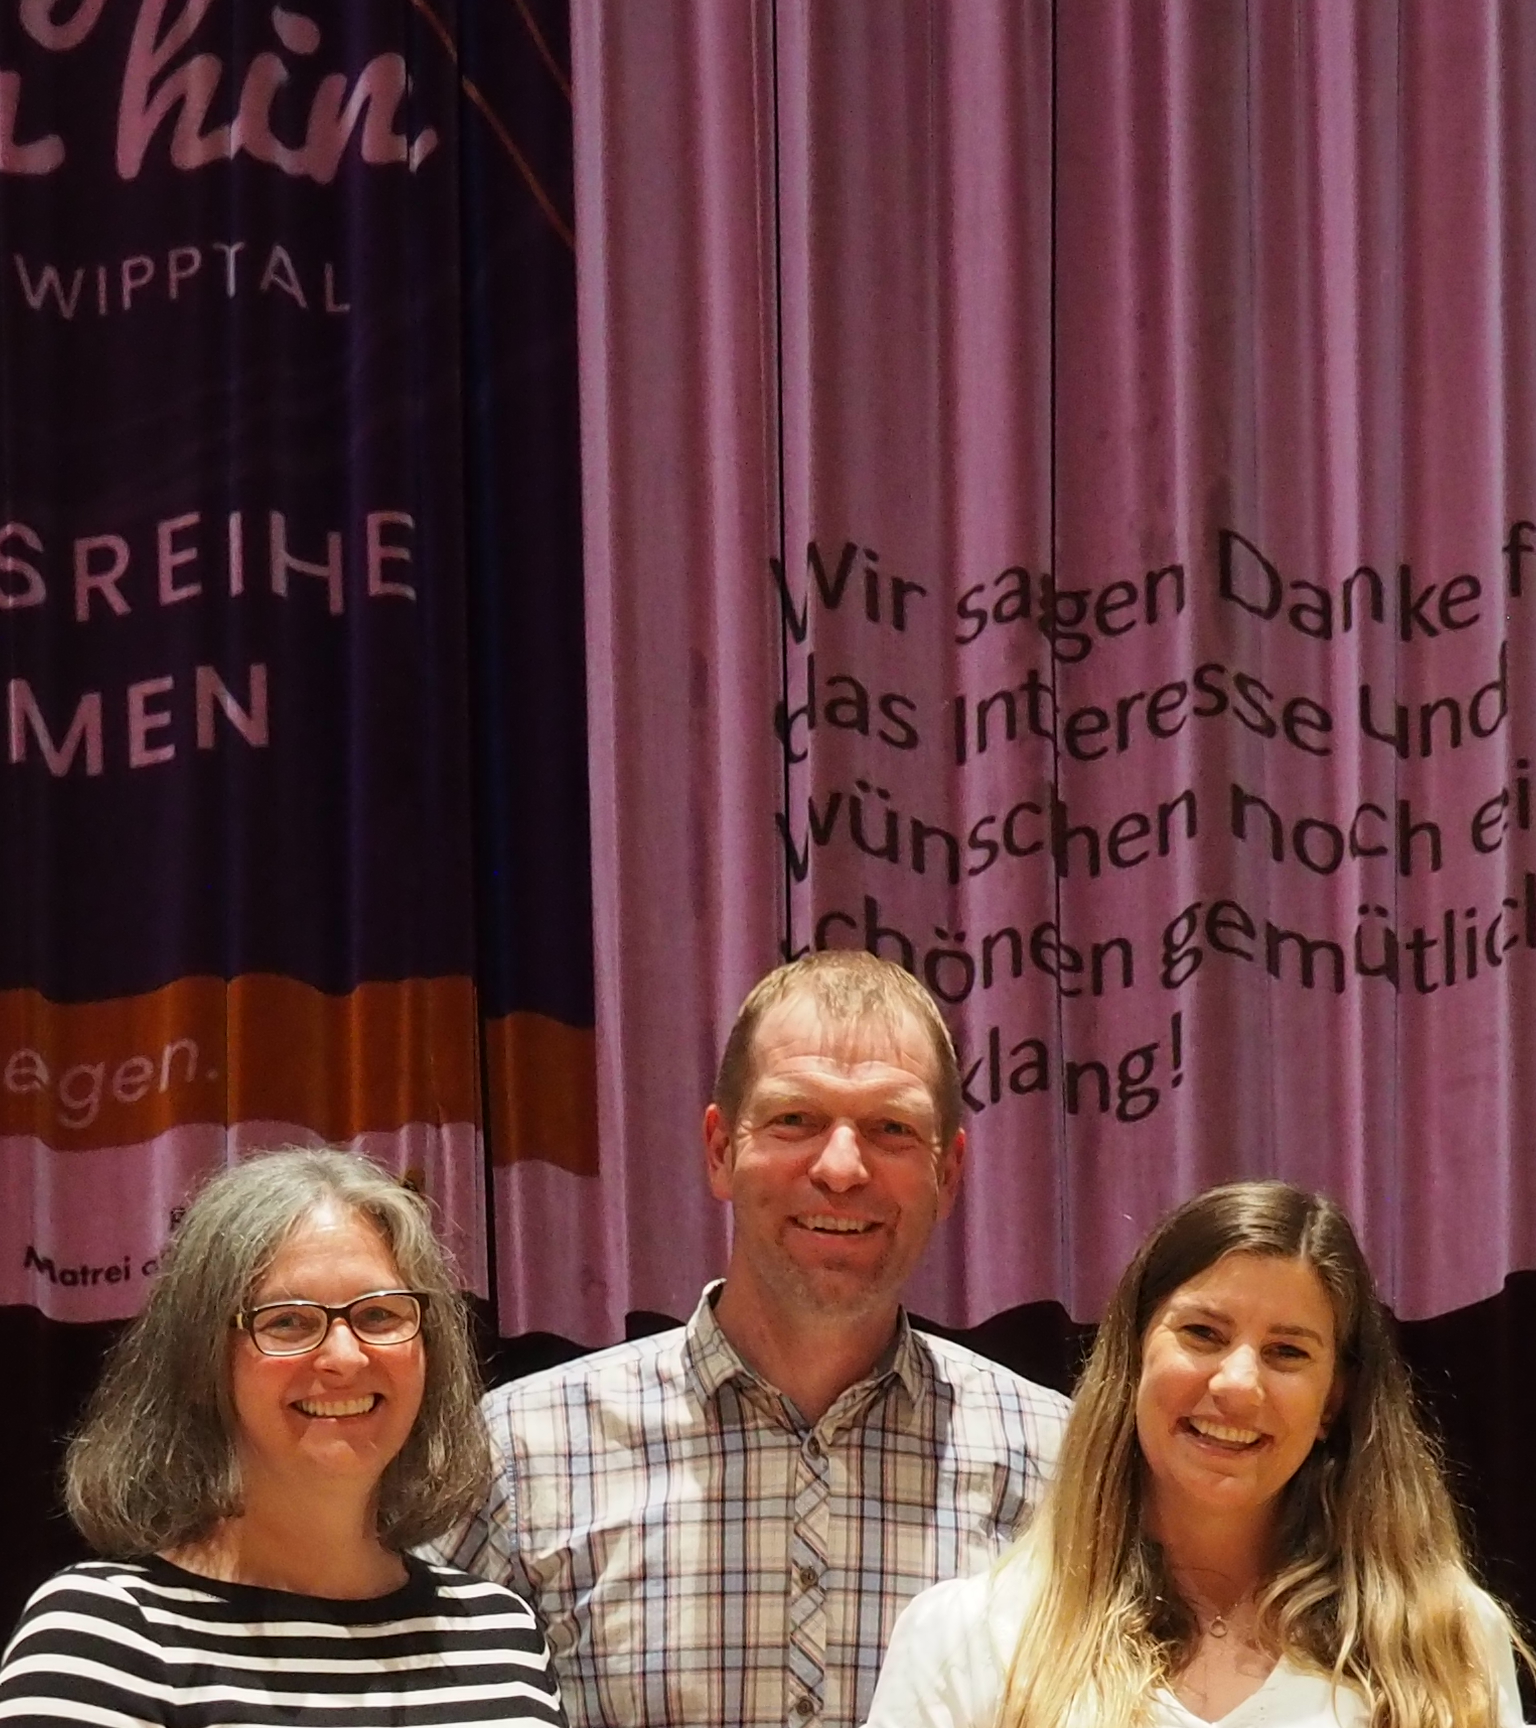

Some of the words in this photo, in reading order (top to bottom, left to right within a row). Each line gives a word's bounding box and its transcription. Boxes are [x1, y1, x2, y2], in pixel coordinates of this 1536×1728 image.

[14, 242, 351, 318] WIPPTAL
[769, 541, 926, 644] Wir
[954, 562, 1188, 663] sagen
[1216, 528, 1482, 641] Danke
[774, 652, 918, 764] das
[954, 661, 1334, 766] Interesse
[1360, 641, 1509, 761] und
[774, 778, 1197, 884] wünschen
[1231, 781, 1443, 878] noch
[23, 1245, 132, 1287] Matrei
